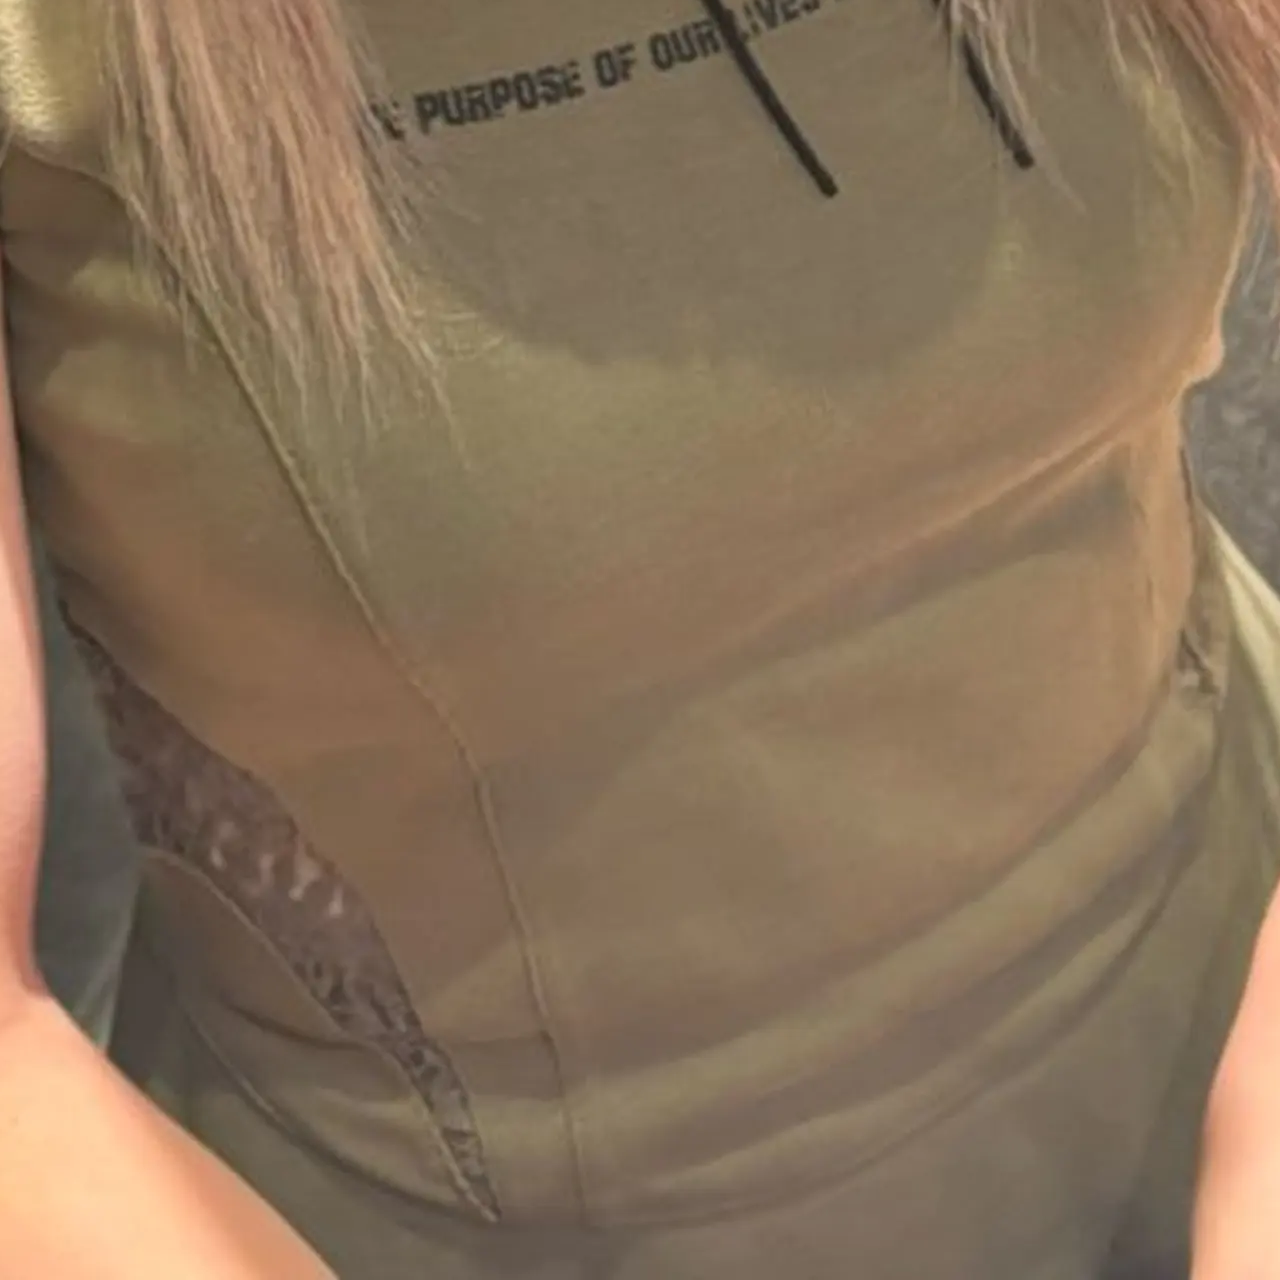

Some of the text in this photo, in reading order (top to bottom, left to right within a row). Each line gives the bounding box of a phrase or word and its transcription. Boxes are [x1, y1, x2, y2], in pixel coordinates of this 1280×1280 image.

[414, 59, 587, 135] PURPOSE
[593, 42, 636, 89] OF
[647, 17, 722, 72] OUR
